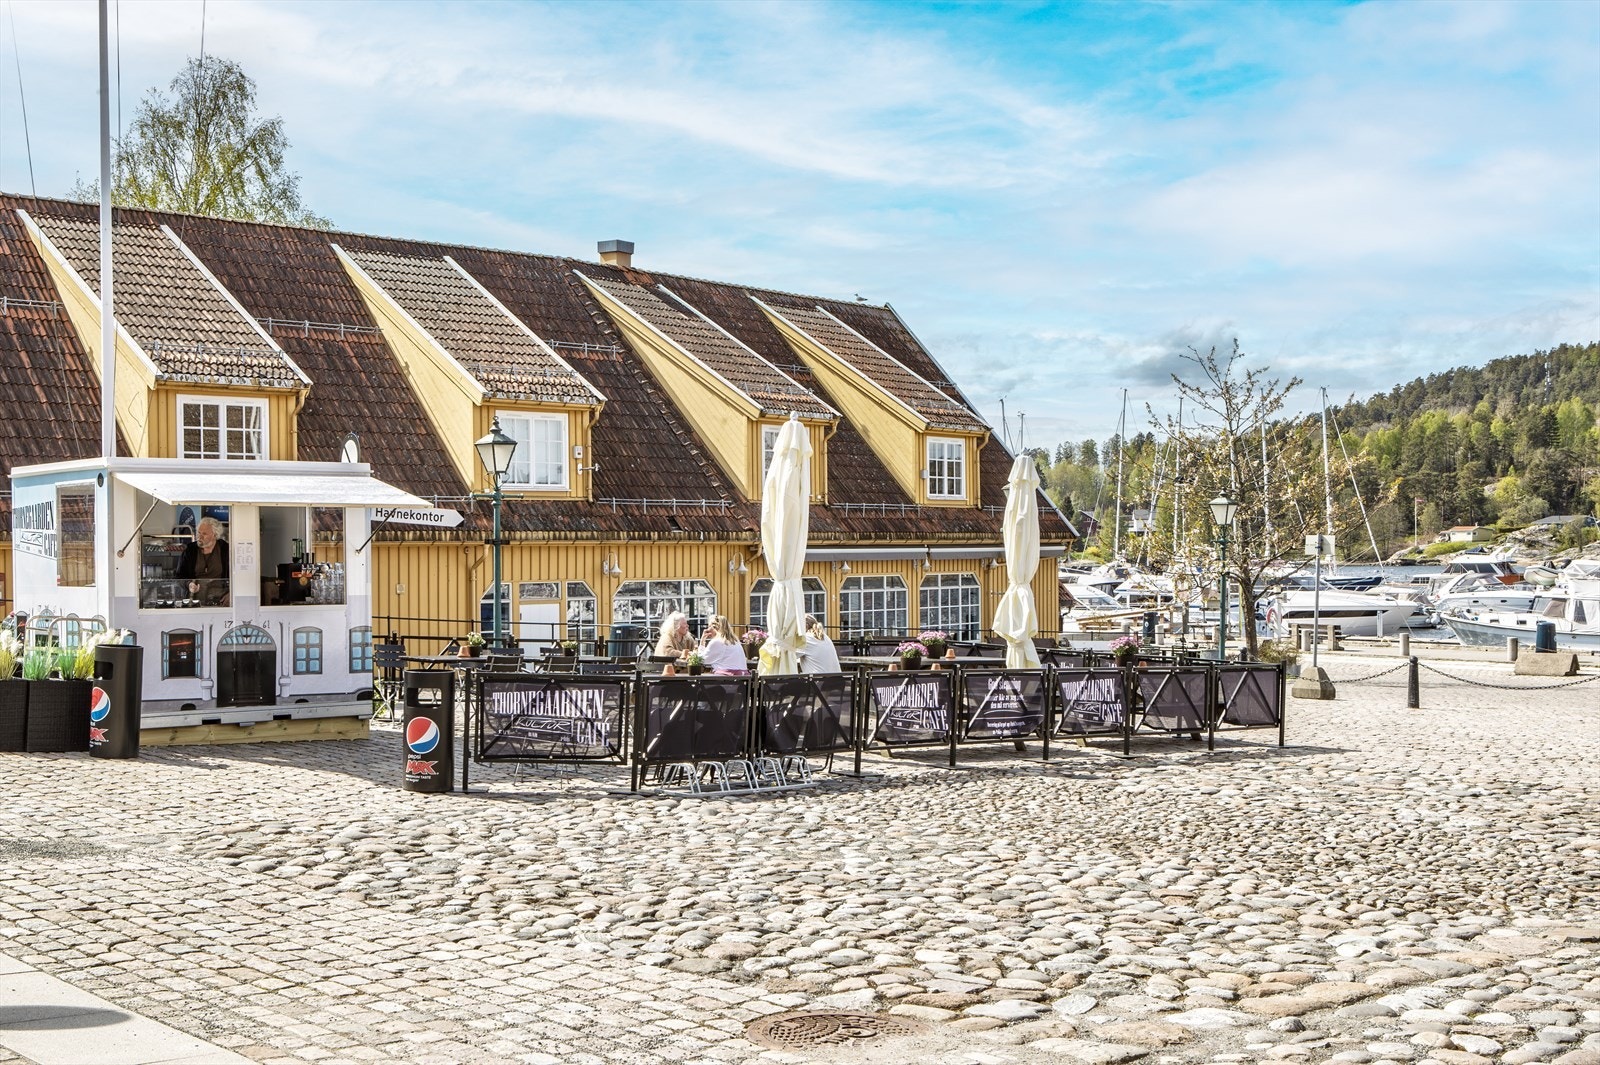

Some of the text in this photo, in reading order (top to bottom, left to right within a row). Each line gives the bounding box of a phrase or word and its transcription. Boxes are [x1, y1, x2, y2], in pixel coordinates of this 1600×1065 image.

[375, 507, 444, 522] Havnekontor
[492, 688, 605, 719] THORNEGAARDEN
[576, 717, 610, 747] CAFÉ
